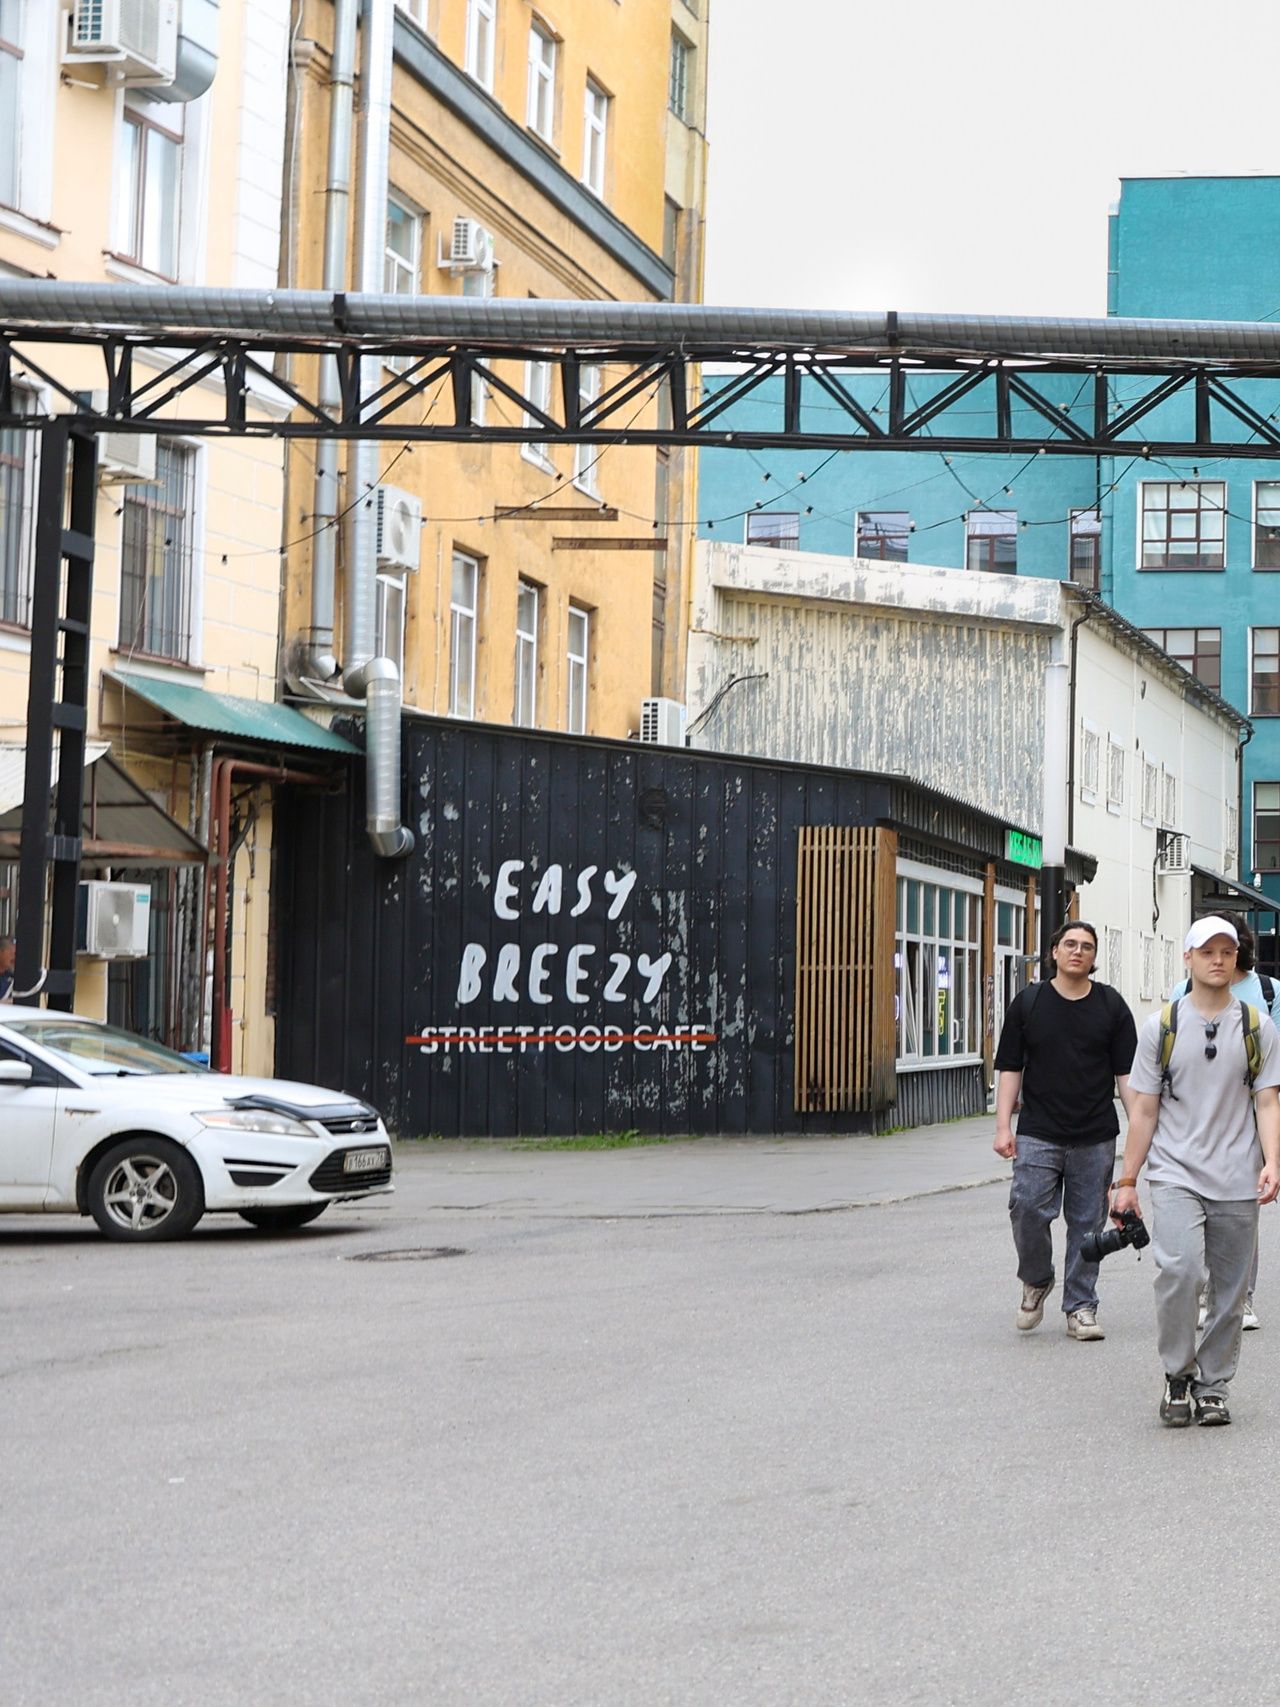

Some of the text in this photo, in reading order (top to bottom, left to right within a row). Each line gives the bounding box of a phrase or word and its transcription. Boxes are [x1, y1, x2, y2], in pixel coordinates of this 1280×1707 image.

[493, 859, 637, 921] EASY
[456, 942, 673, 1005] BREEZY
[633, 1024, 707, 1051] CAFE
